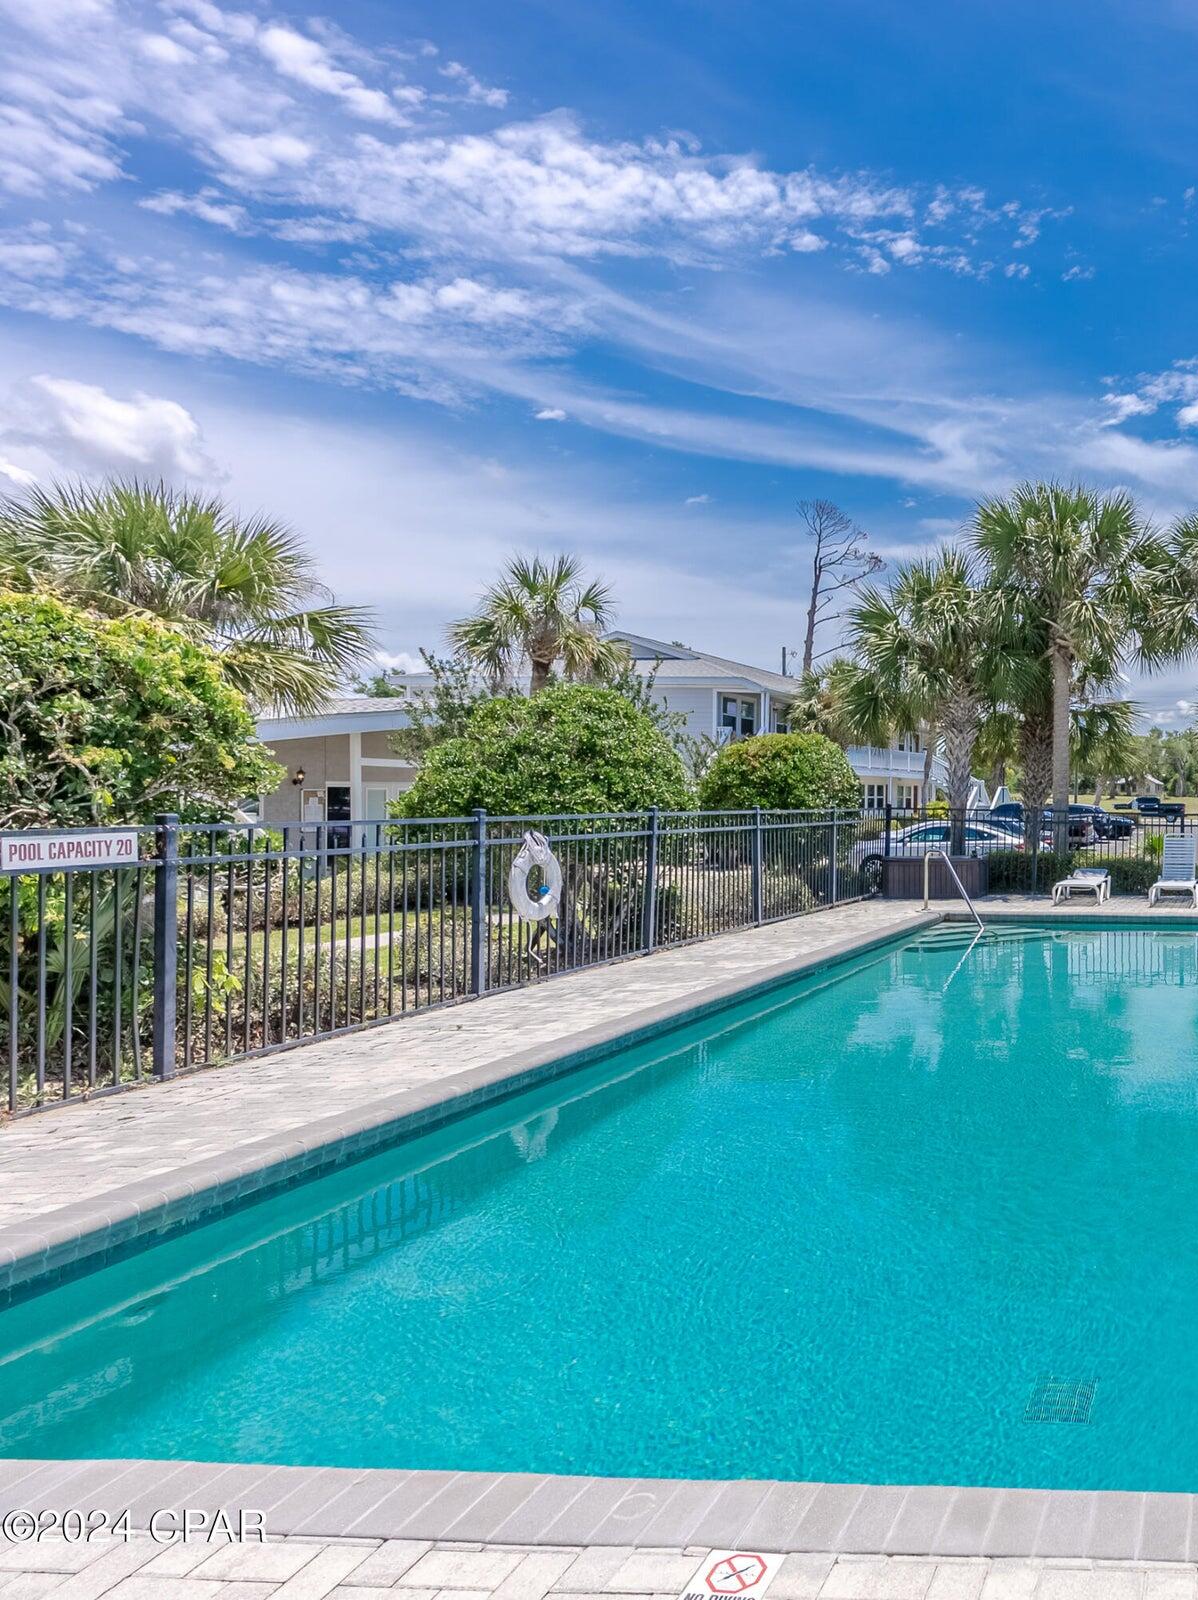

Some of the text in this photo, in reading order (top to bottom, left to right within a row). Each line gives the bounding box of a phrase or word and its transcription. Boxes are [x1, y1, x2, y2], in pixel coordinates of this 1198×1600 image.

[8, 838, 133, 862] POOL CAPACITY 20
